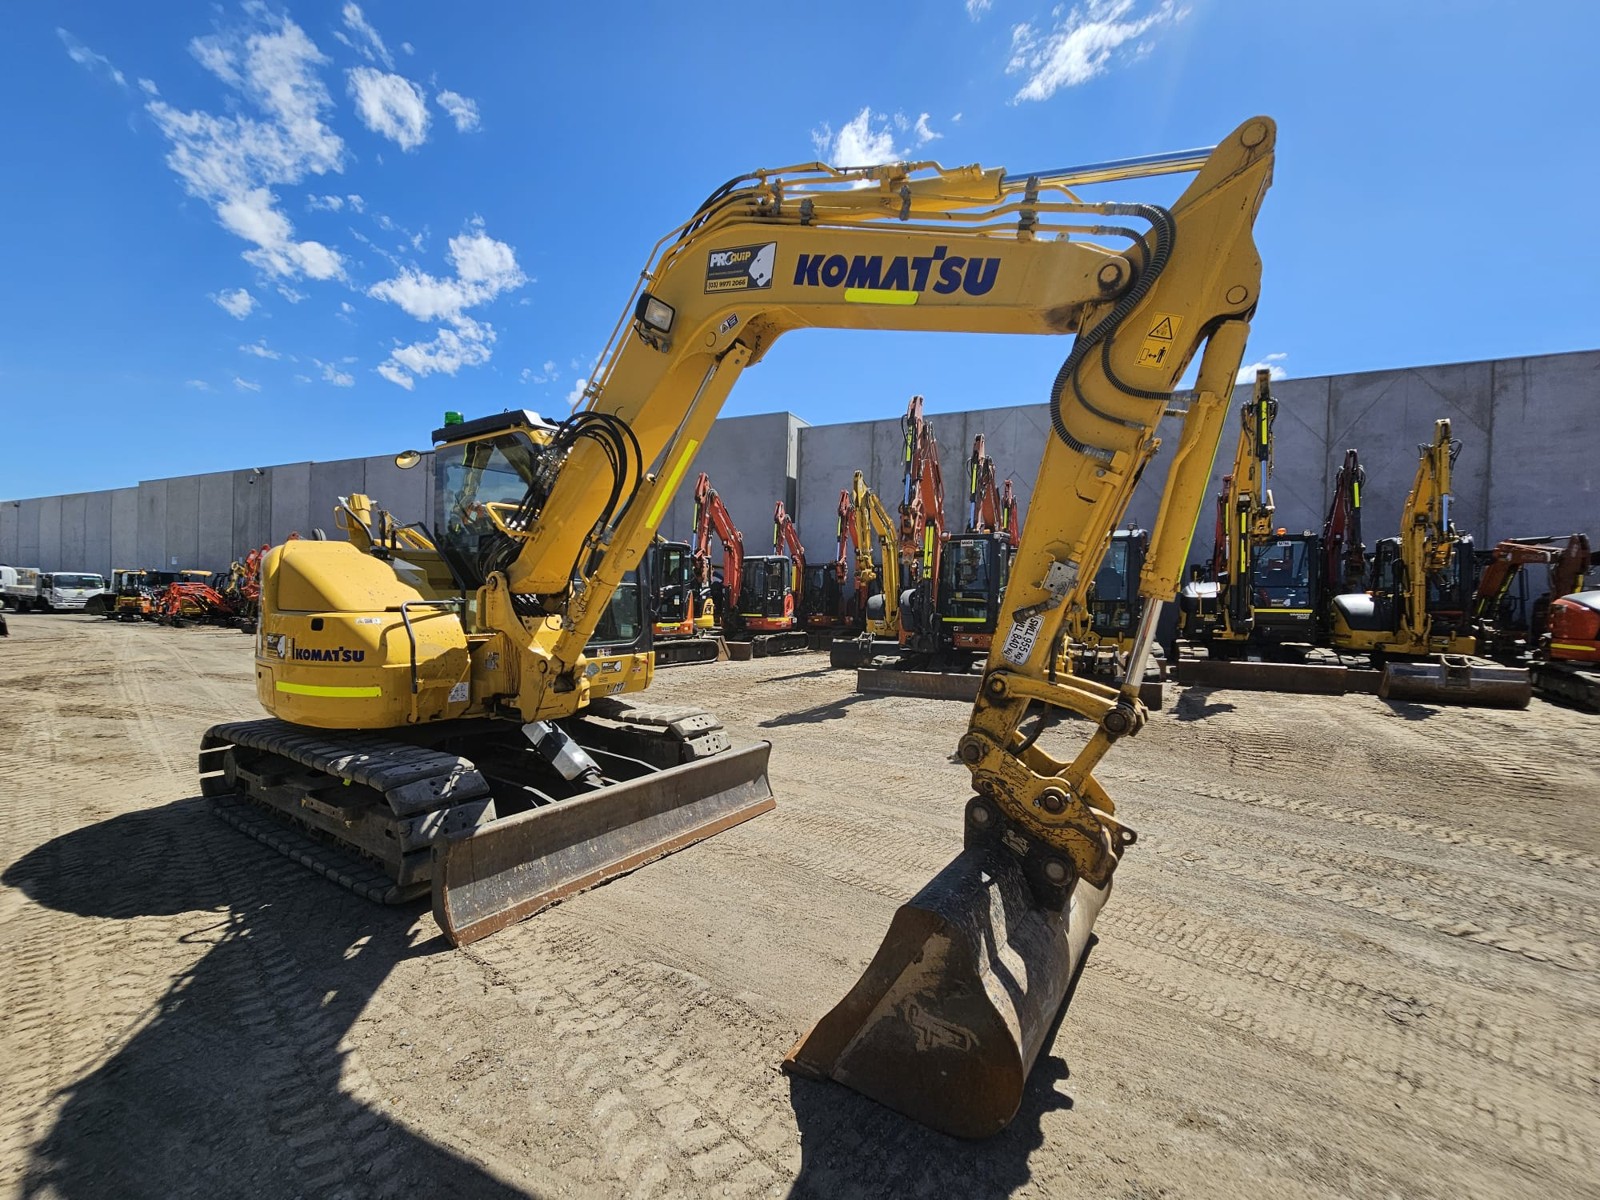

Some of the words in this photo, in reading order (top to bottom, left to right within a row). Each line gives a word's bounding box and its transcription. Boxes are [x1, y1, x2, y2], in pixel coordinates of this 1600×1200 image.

[793, 245, 1001, 296] KOMATSU
[1024, 618, 1039, 636] SWLL
[1009, 633, 1022, 649] 840
[1019, 637, 1032, 653] 955
[296, 646, 364, 662] KOMATSU
